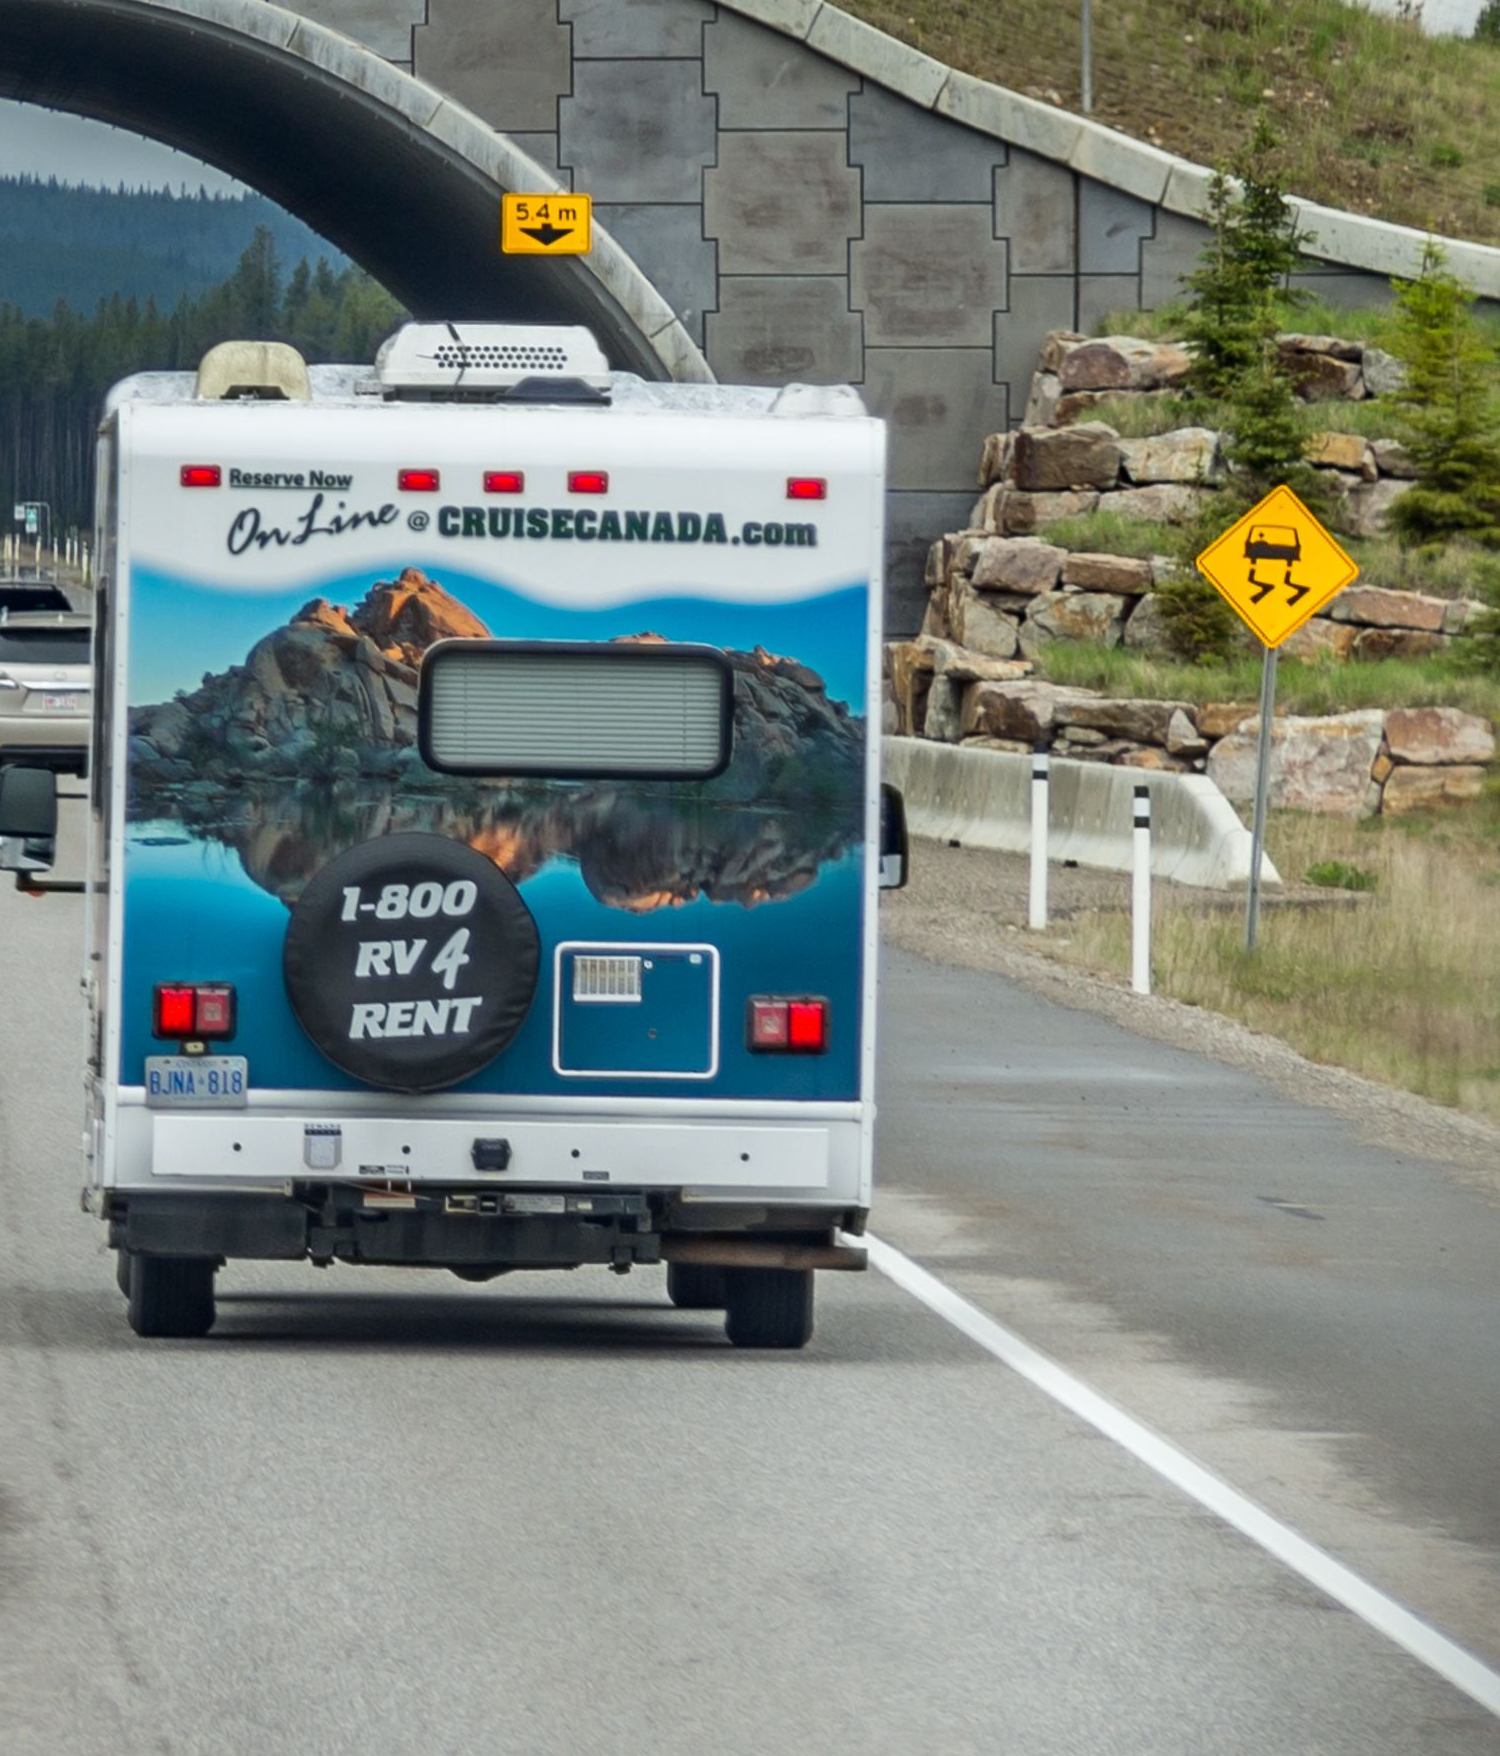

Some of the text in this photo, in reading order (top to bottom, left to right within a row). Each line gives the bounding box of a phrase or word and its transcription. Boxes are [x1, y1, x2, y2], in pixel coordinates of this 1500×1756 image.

[516, 203, 577, 221] 5.4 m
[229, 468, 353, 489] Reserve Now
[227, 507, 290, 555] On
[292, 493, 400, 545] Line
[437, 505, 819, 548] CRUISECANADA.com
[341, 879, 478, 921] 1-800
[355, 927, 470, 990] RV 4
[348, 995, 483, 1039] RENT
